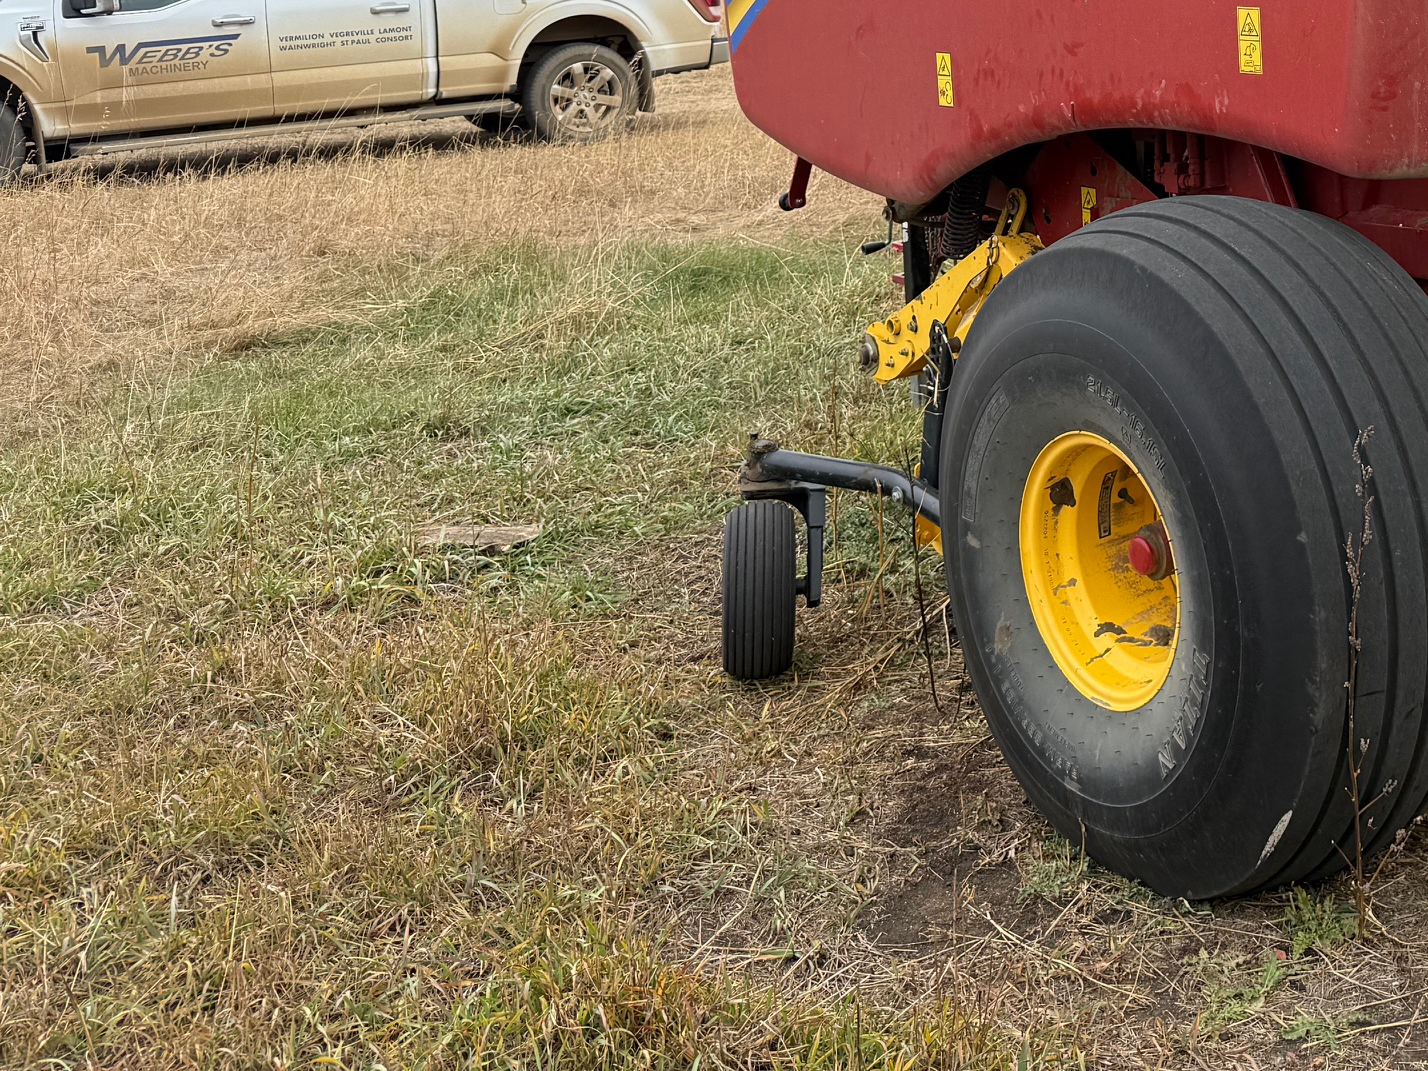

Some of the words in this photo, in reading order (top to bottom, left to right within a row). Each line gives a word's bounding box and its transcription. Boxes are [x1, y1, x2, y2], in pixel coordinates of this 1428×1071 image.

[278, 33, 325, 43] VERMILION
[329, 28, 375, 39] VEGREVILLE
[378, 25, 413, 35] LAMONT
[278, 41, 337, 52] WAINWRIGHT
[375, 34, 414, 45] CONSORT
[86, 33, 242, 68] WEBB'S
[129, 60, 209, 77] MACHINERY
[1157, 646, 1211, 780] TITAN
